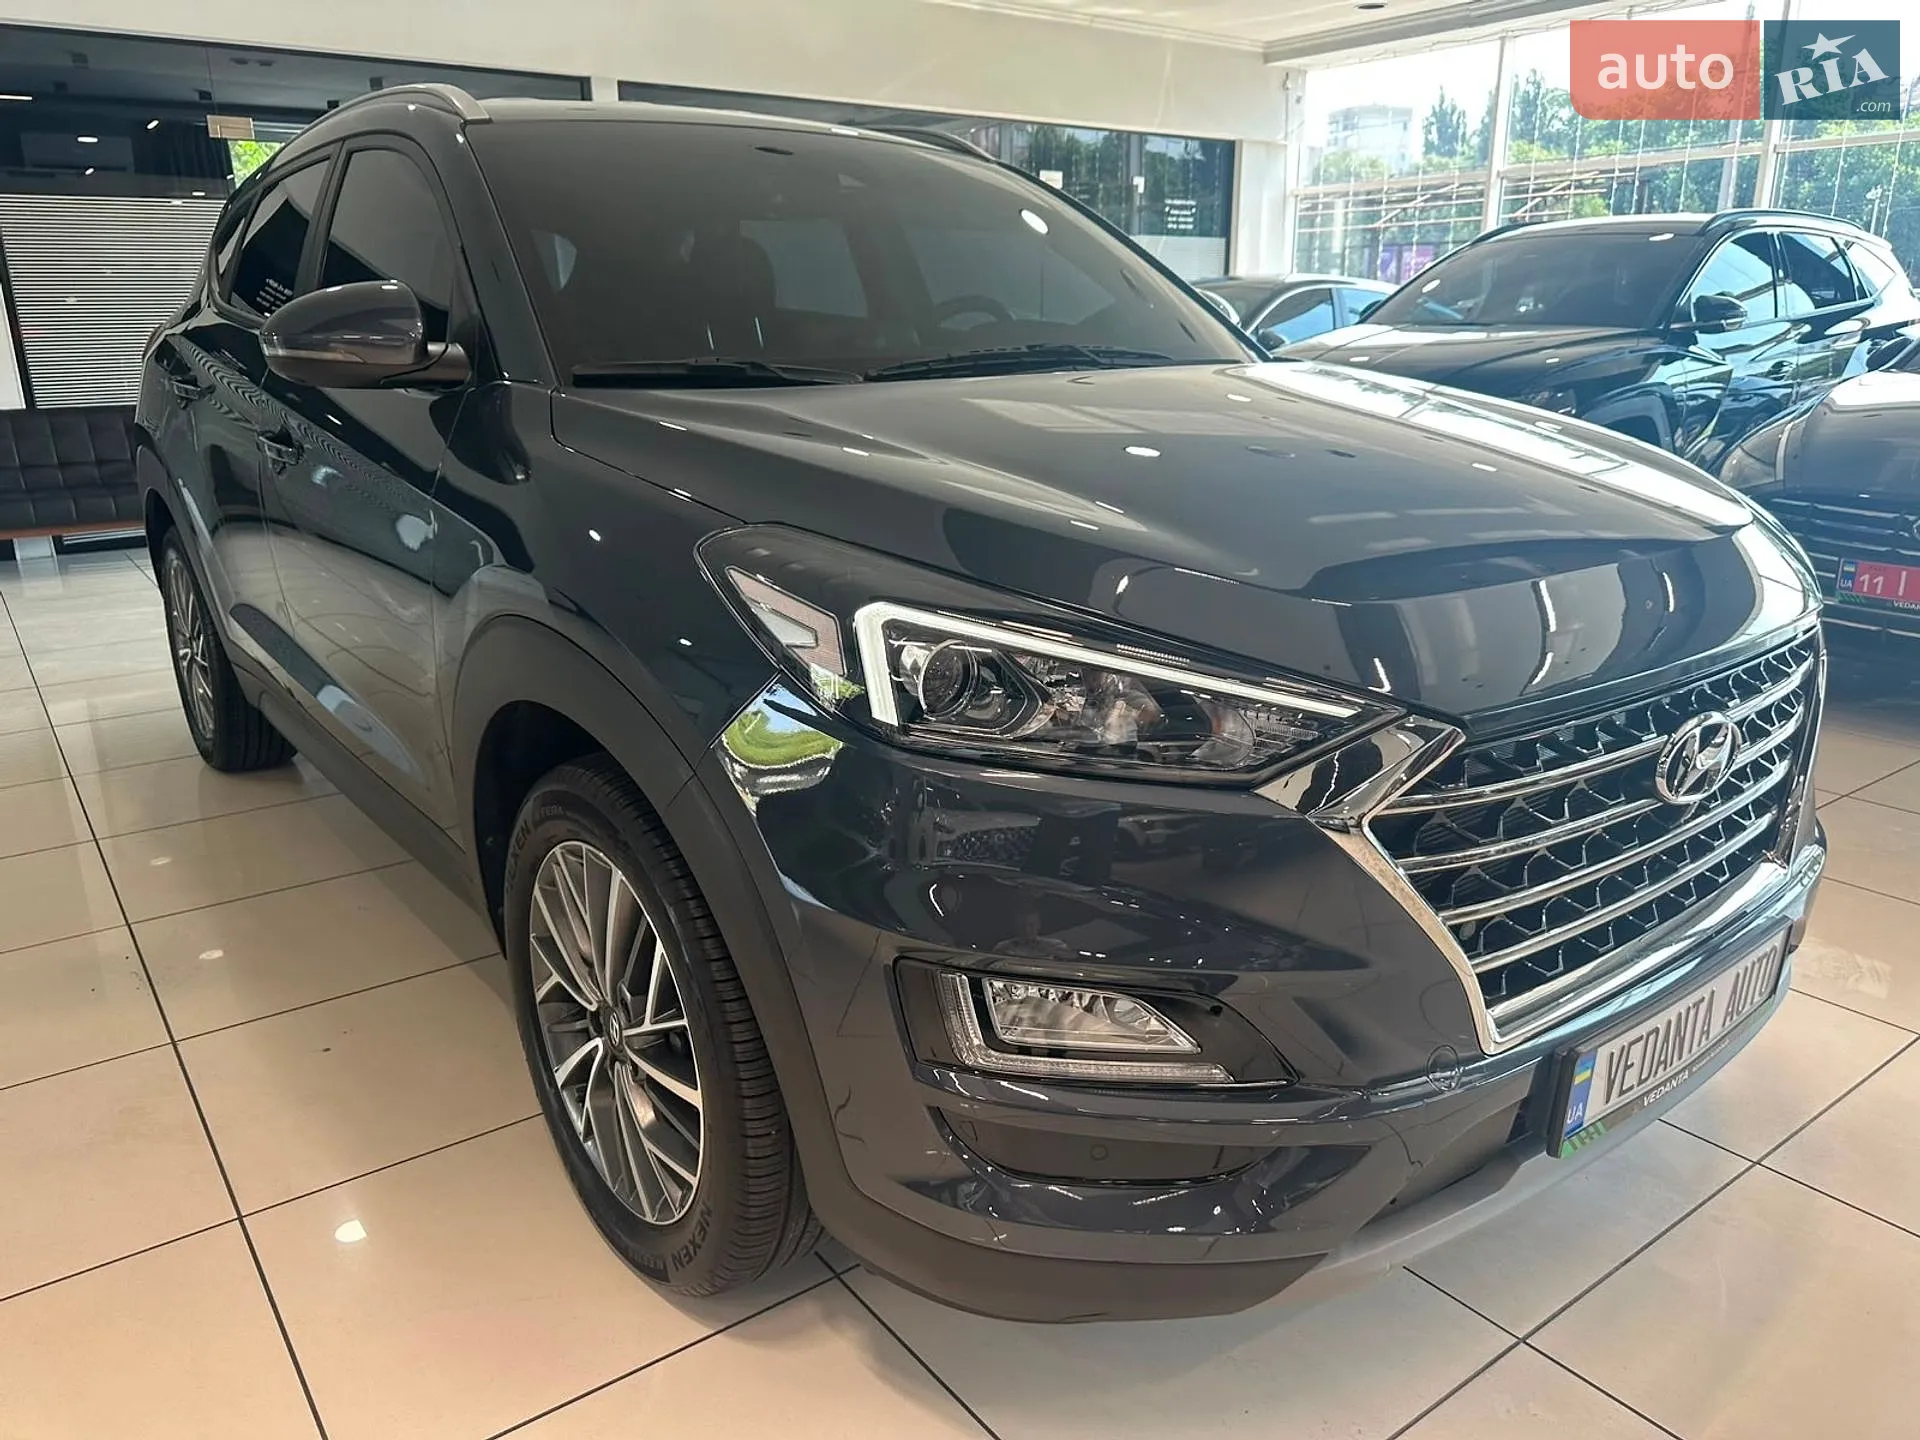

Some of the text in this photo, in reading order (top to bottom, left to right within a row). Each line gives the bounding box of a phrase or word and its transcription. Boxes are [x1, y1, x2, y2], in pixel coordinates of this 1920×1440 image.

[1859, 574, 1884, 595] 11
[1605, 942, 1780, 1105] VEDANTA AUTO
[1643, 1069, 1689, 1106] VEDANTA
[1566, 1102, 1583, 1124] UA
